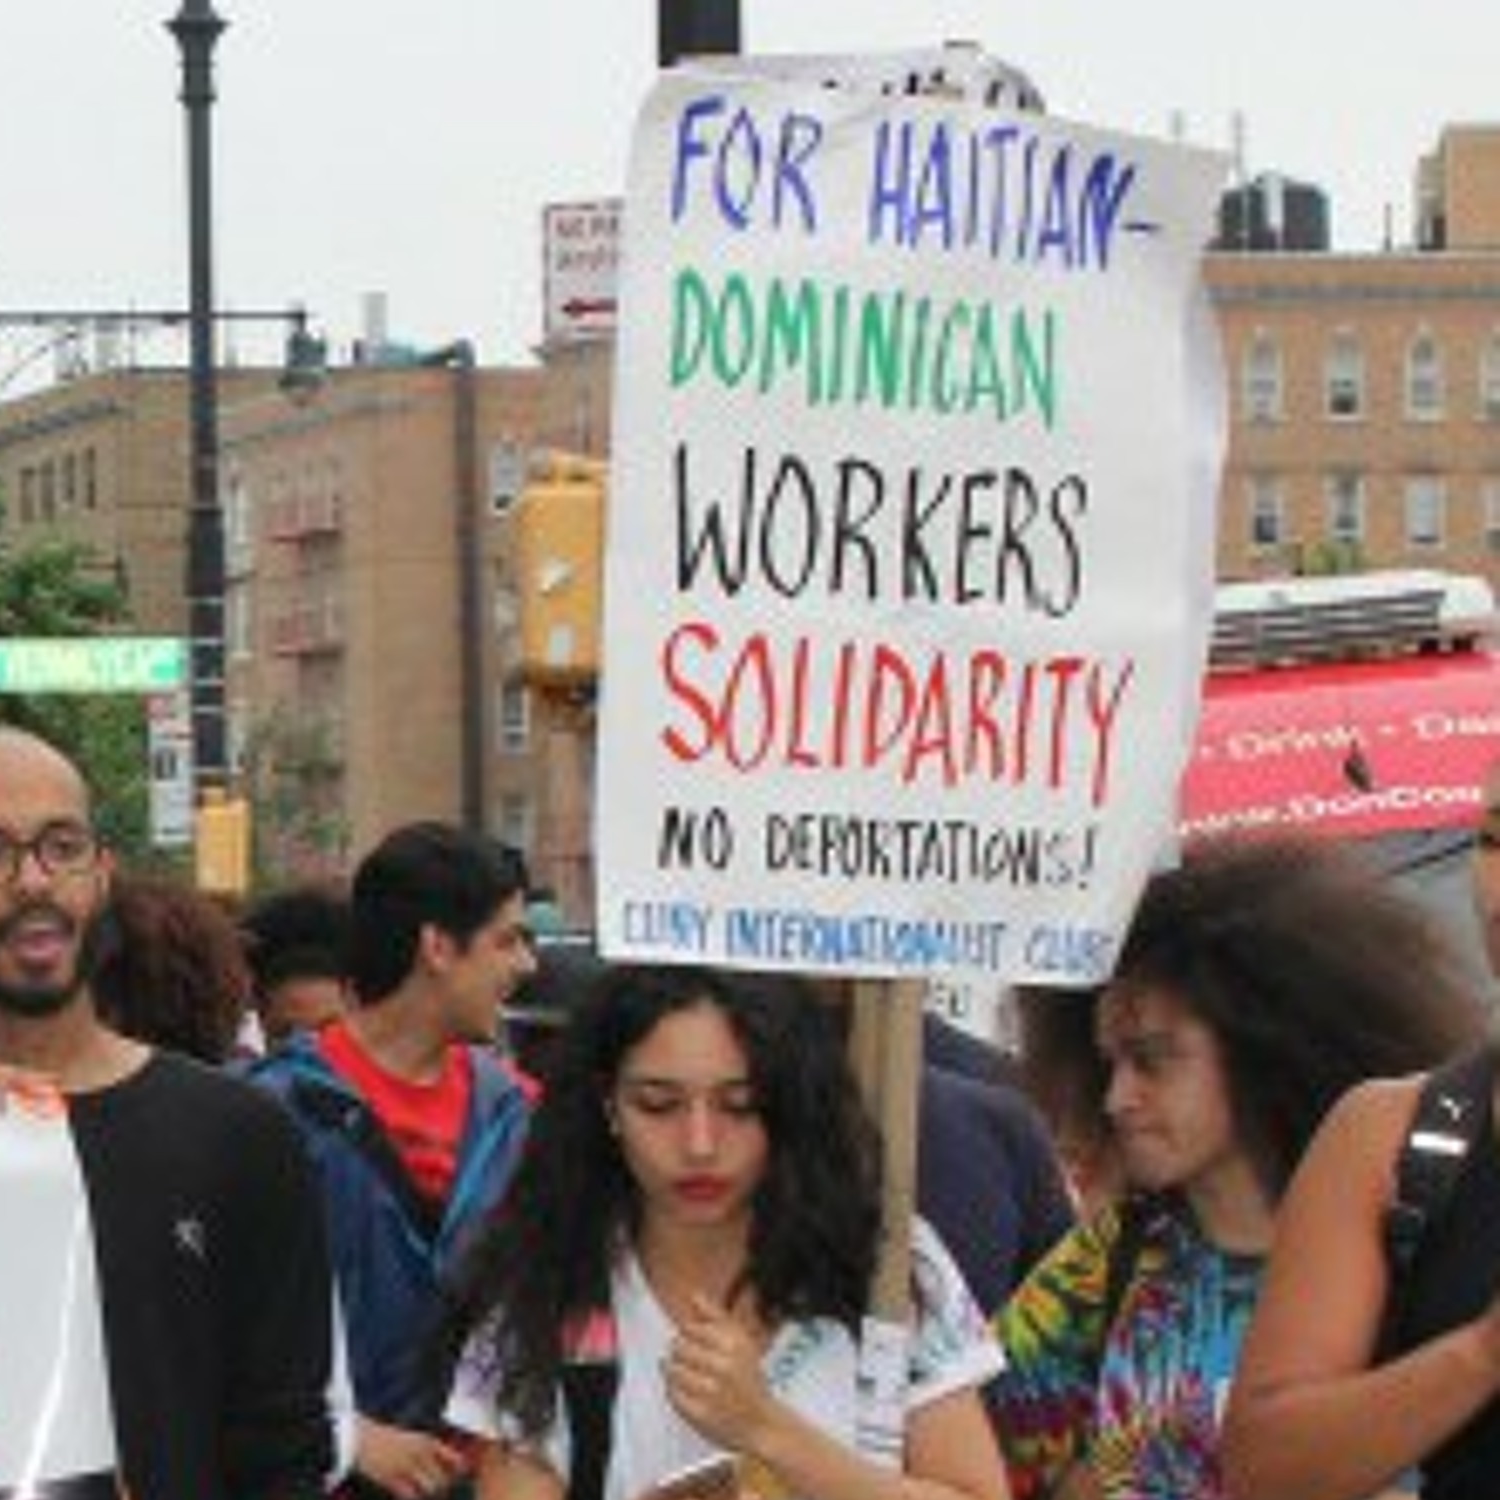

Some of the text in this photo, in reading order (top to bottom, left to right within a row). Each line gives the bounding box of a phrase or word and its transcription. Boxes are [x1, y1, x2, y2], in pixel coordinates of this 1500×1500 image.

[670, 96, 1160, 272] FOR HAITIAN-
[670, 268, 1056, 432] DOMINICAN
[675, 440, 1090, 618] WORKERS
[660, 622, 1135, 810] SOLIDARITY
[658, 806, 1098, 892] NO DEPORTATIONS!
